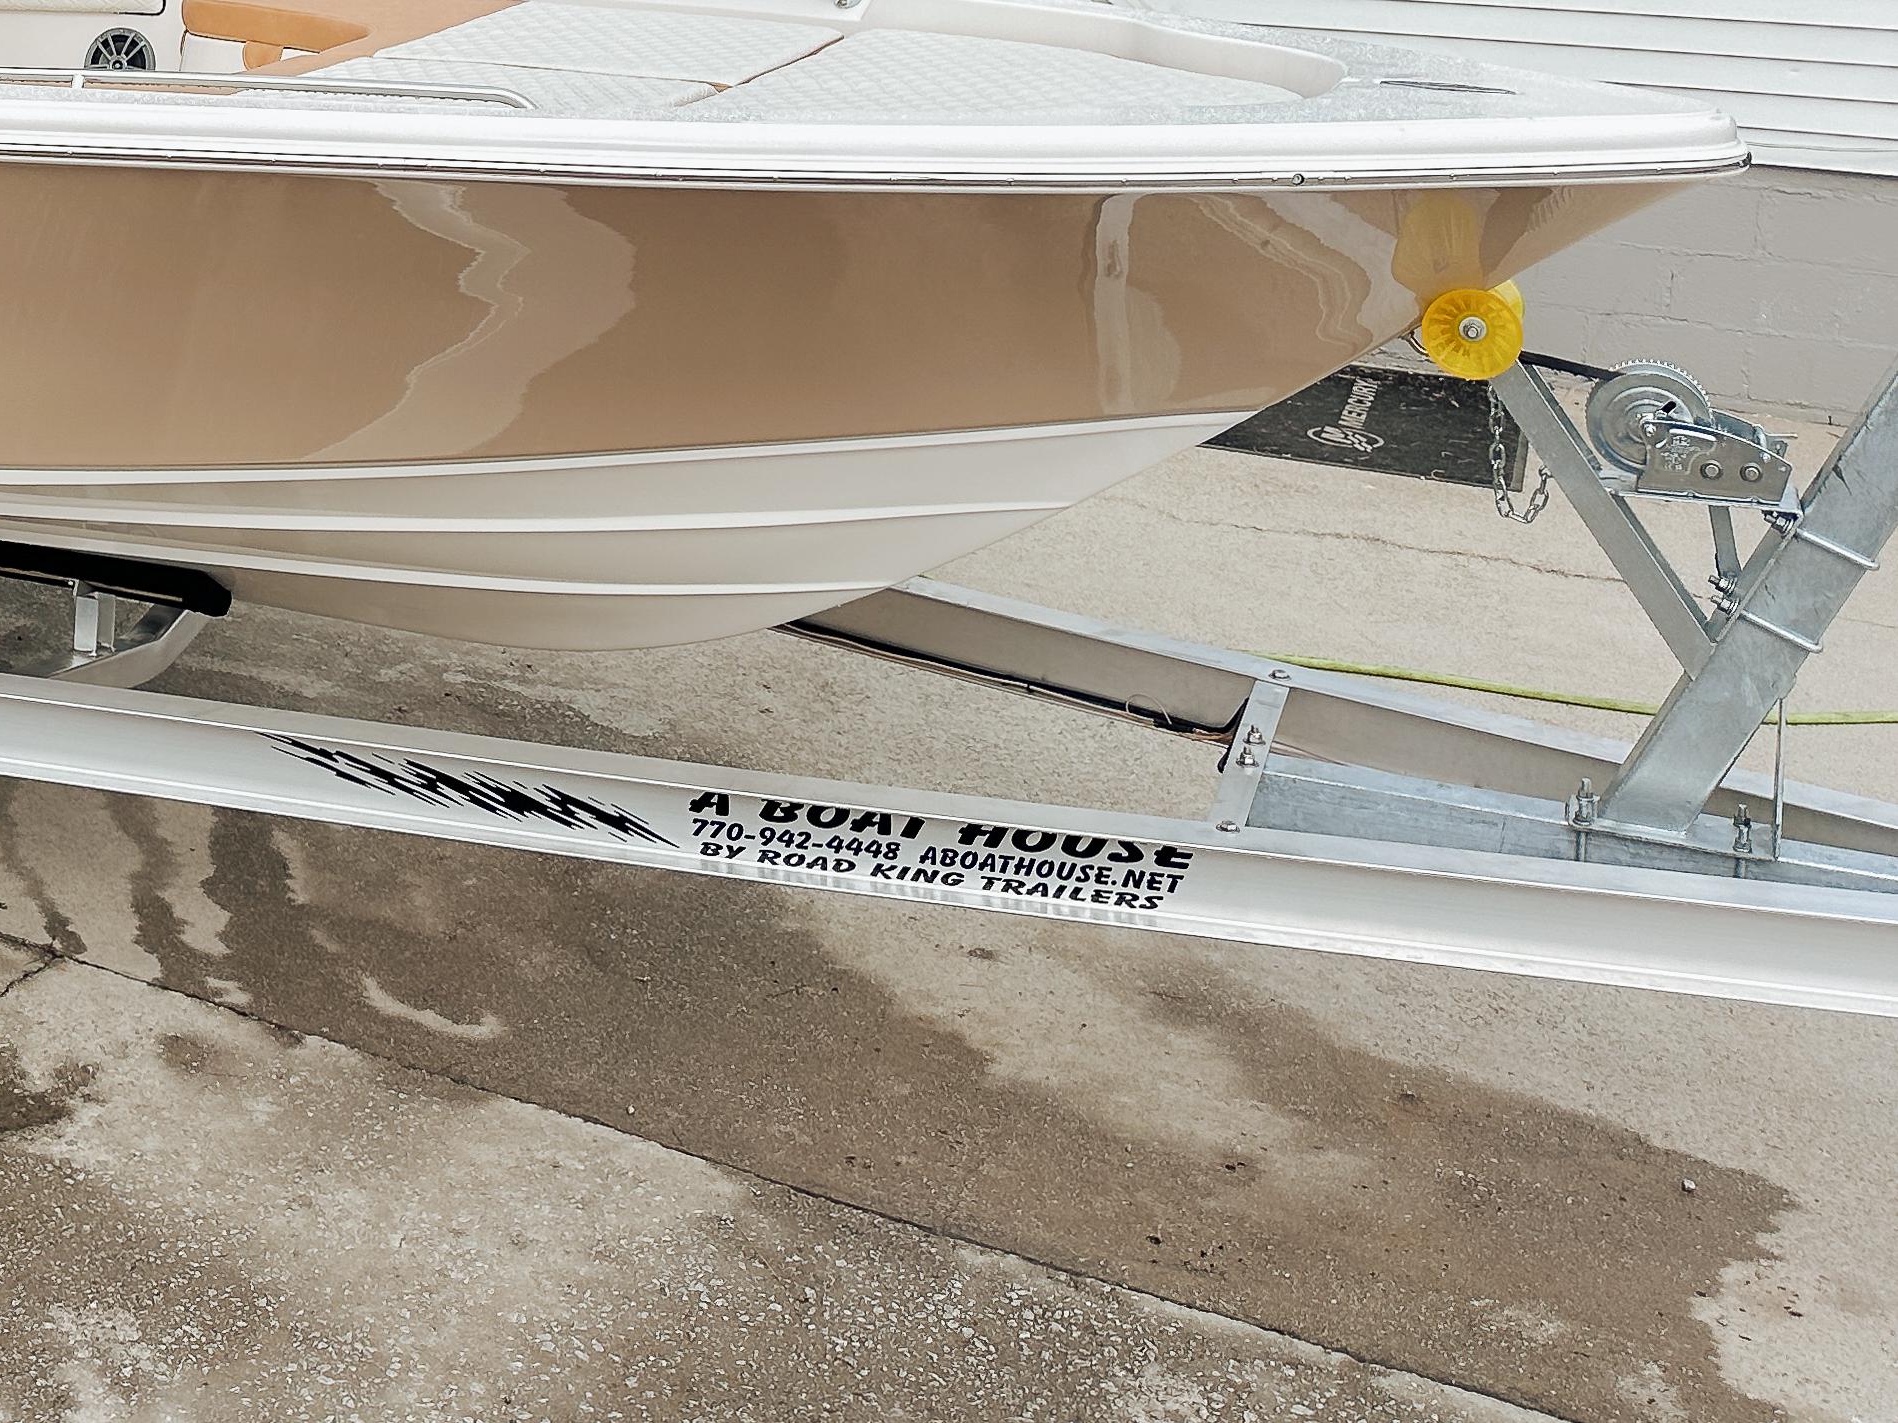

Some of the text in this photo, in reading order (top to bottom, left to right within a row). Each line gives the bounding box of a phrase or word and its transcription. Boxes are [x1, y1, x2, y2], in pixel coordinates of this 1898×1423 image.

[1338, 377, 1378, 430] MERCURY
[689, 792, 1193, 869] A BOAT HOUSE
[691, 818, 1184, 893] 770-942-4448 ABOATHOUSE.NET
[699, 842, 1164, 910] BY ROAD KING TRAILERS
